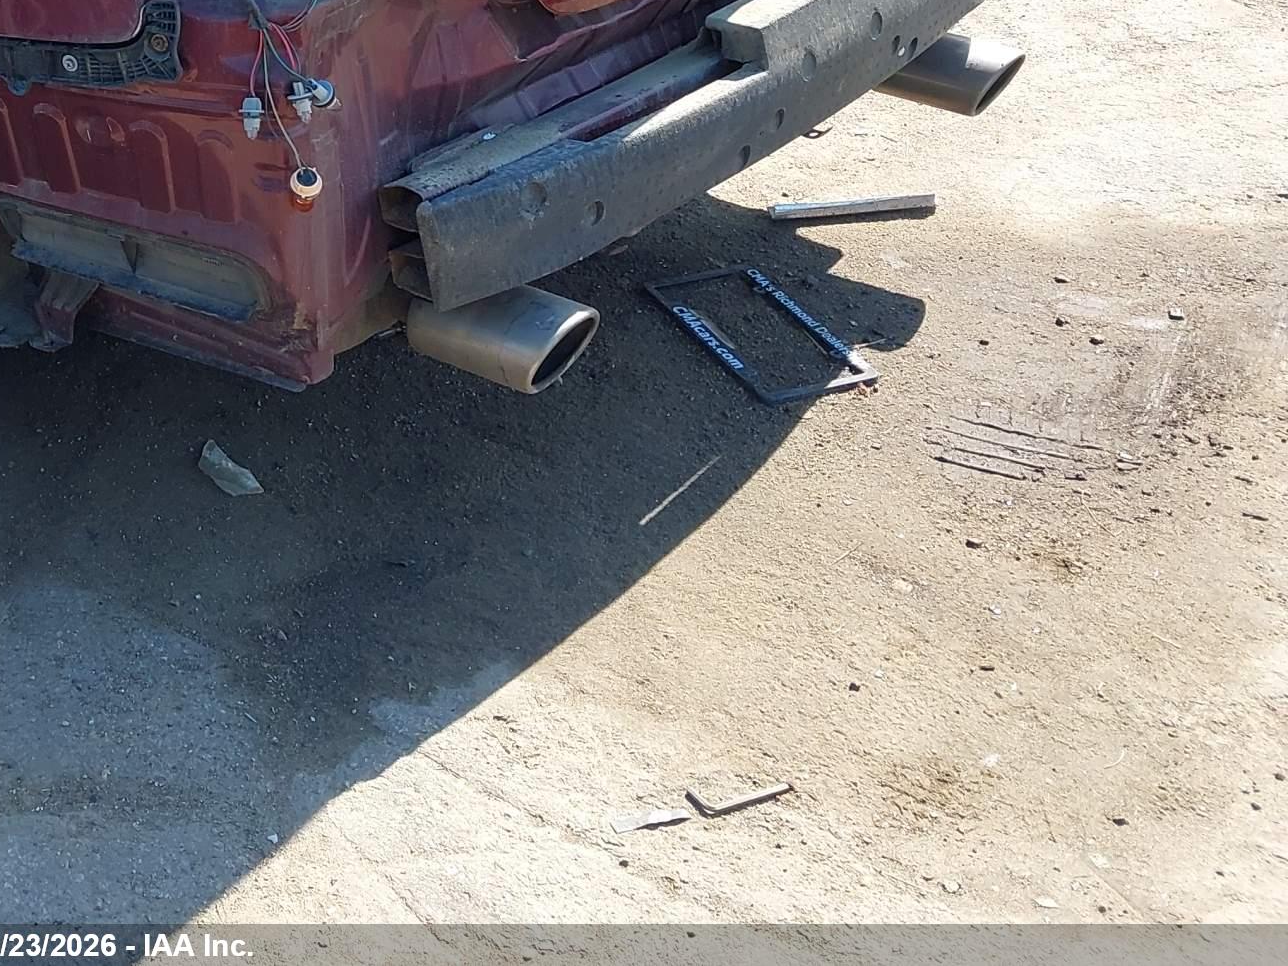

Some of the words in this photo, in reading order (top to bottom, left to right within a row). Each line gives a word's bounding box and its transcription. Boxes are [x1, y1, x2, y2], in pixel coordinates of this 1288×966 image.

[672, 305, 744, 371] CMAcars.com
[746, 267, 775, 293] CMA's
[772, 290, 820, 327] Richmond
[814, 325, 852, 355] Dealers
